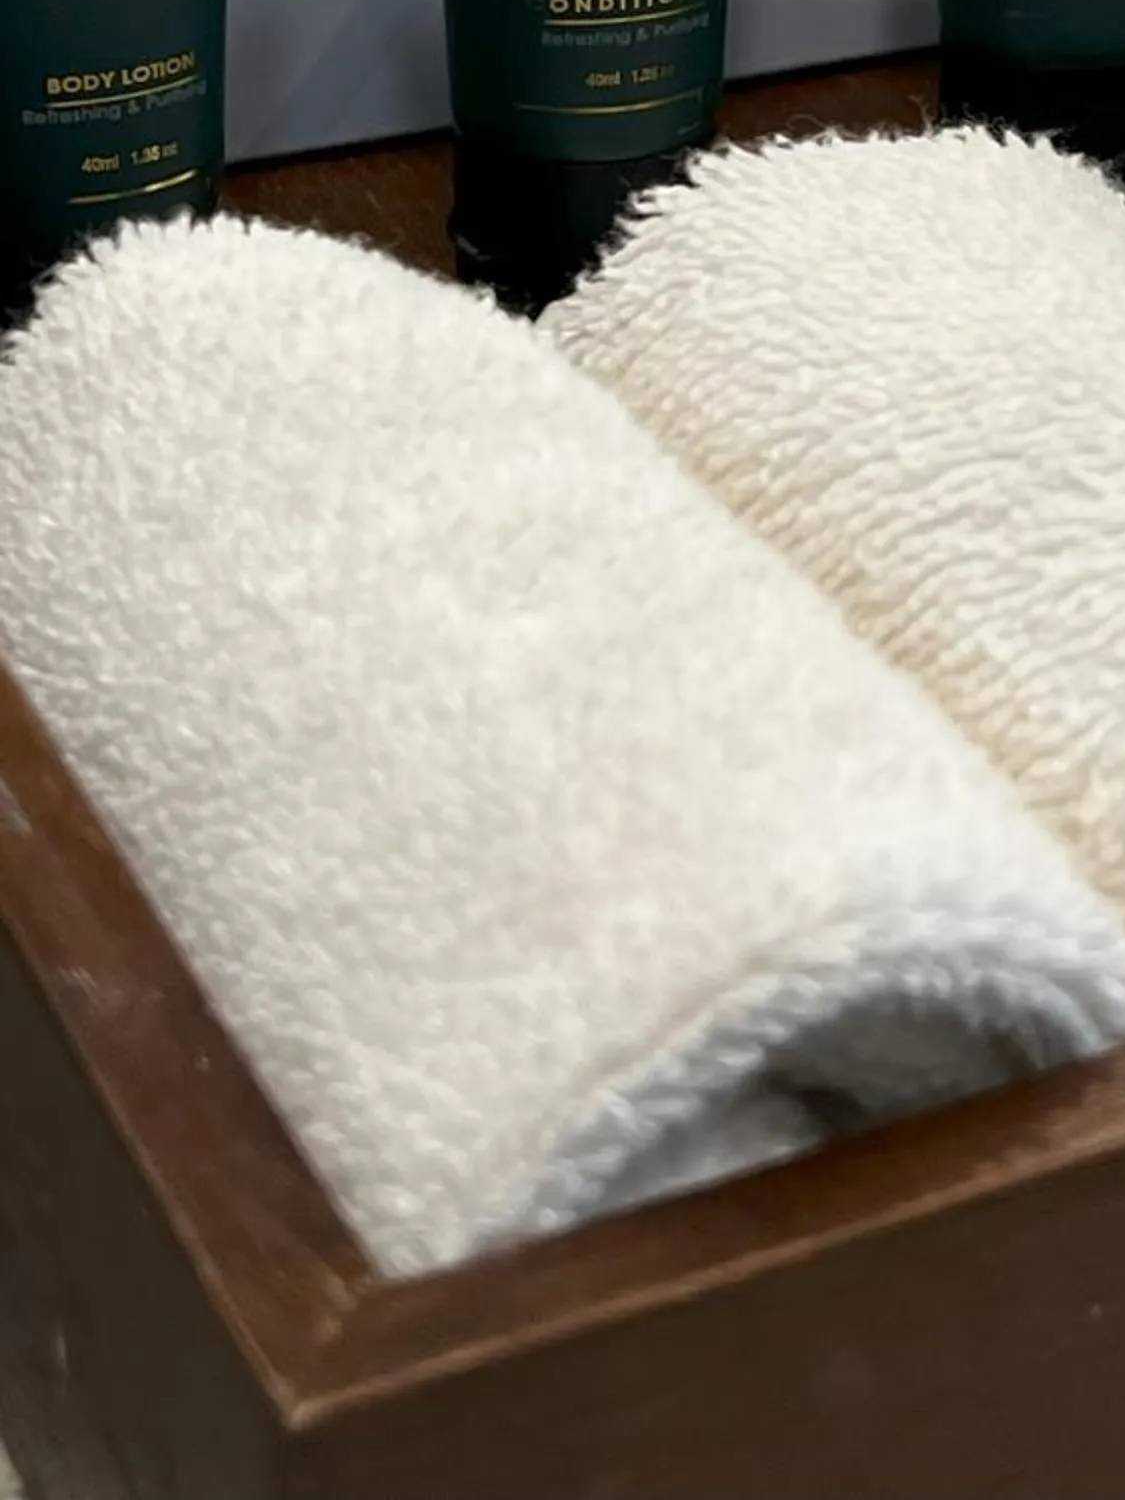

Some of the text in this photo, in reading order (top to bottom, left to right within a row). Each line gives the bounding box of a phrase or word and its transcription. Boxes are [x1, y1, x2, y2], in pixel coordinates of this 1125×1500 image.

[47, 52, 196, 95] BODY LOTION
[127, 100, 141, 115] &
